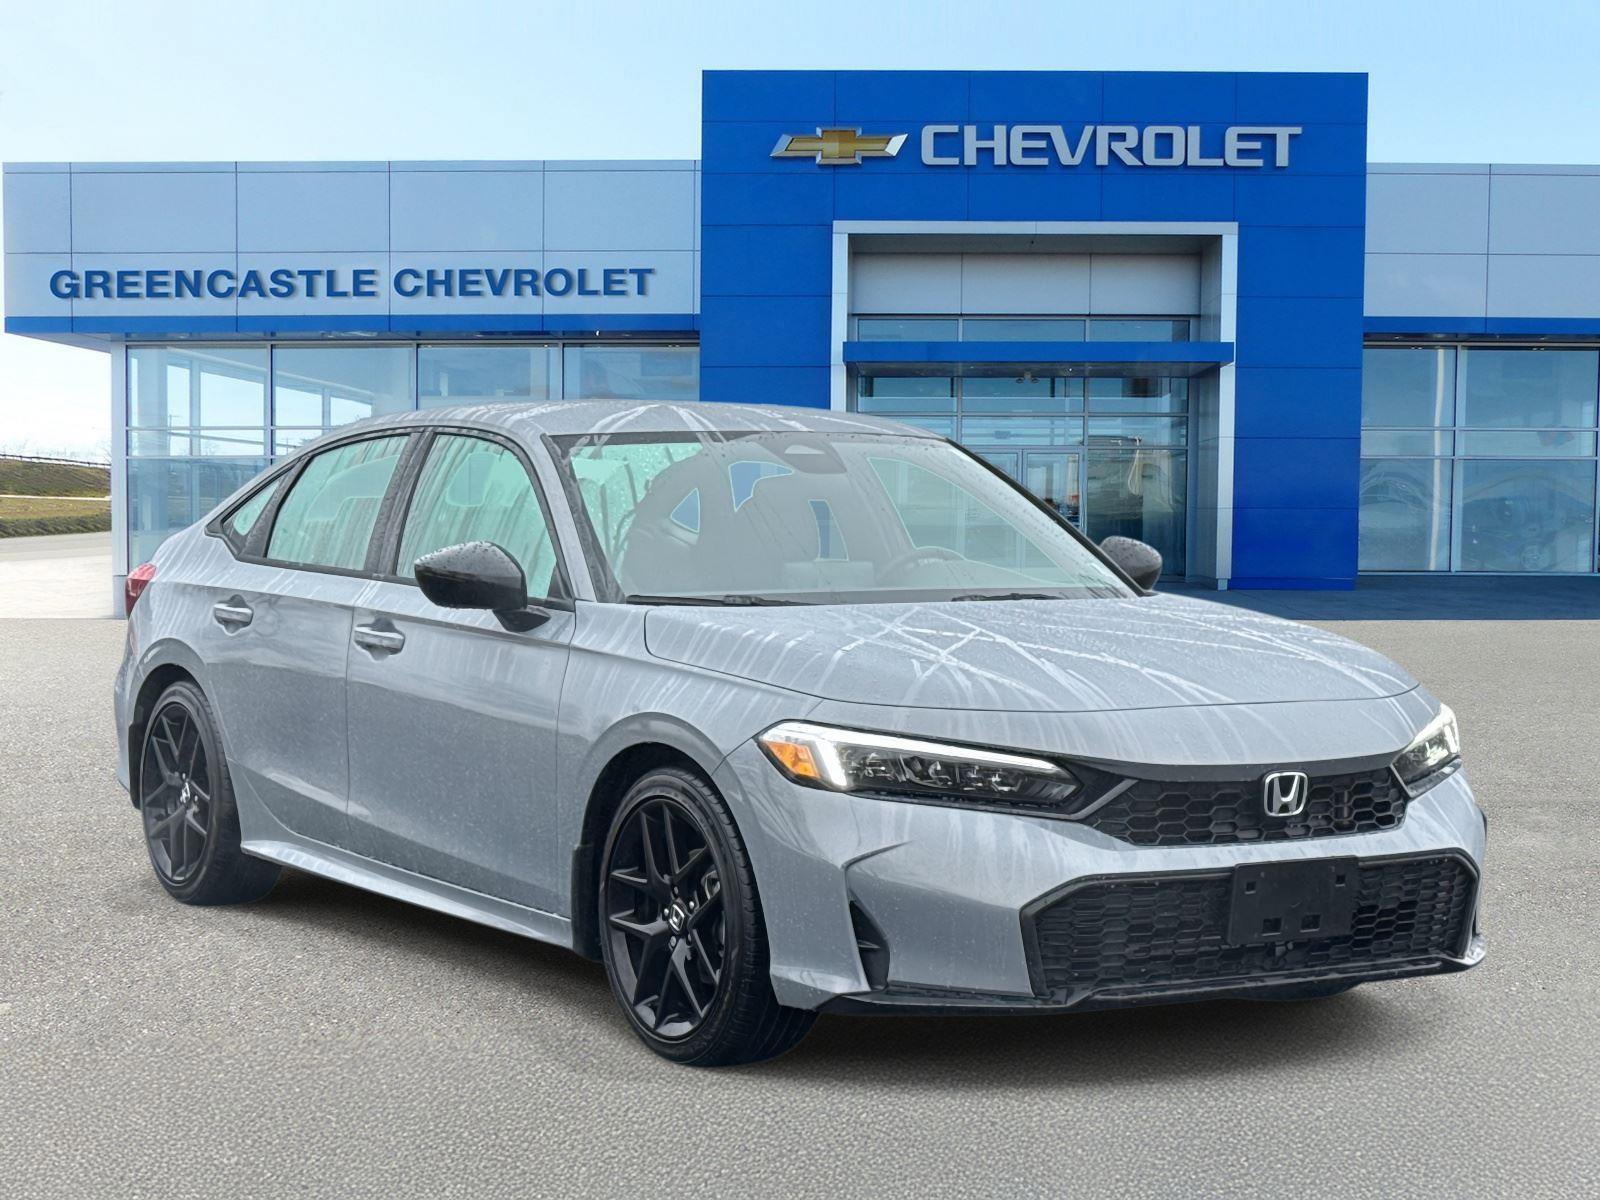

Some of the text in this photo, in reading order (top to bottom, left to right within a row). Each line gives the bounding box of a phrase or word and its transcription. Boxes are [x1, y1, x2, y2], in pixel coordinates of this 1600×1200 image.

[921, 125, 1302, 167] CHEVROLET
[50, 267, 655, 299] GREENCASTLE CHEVROLET
